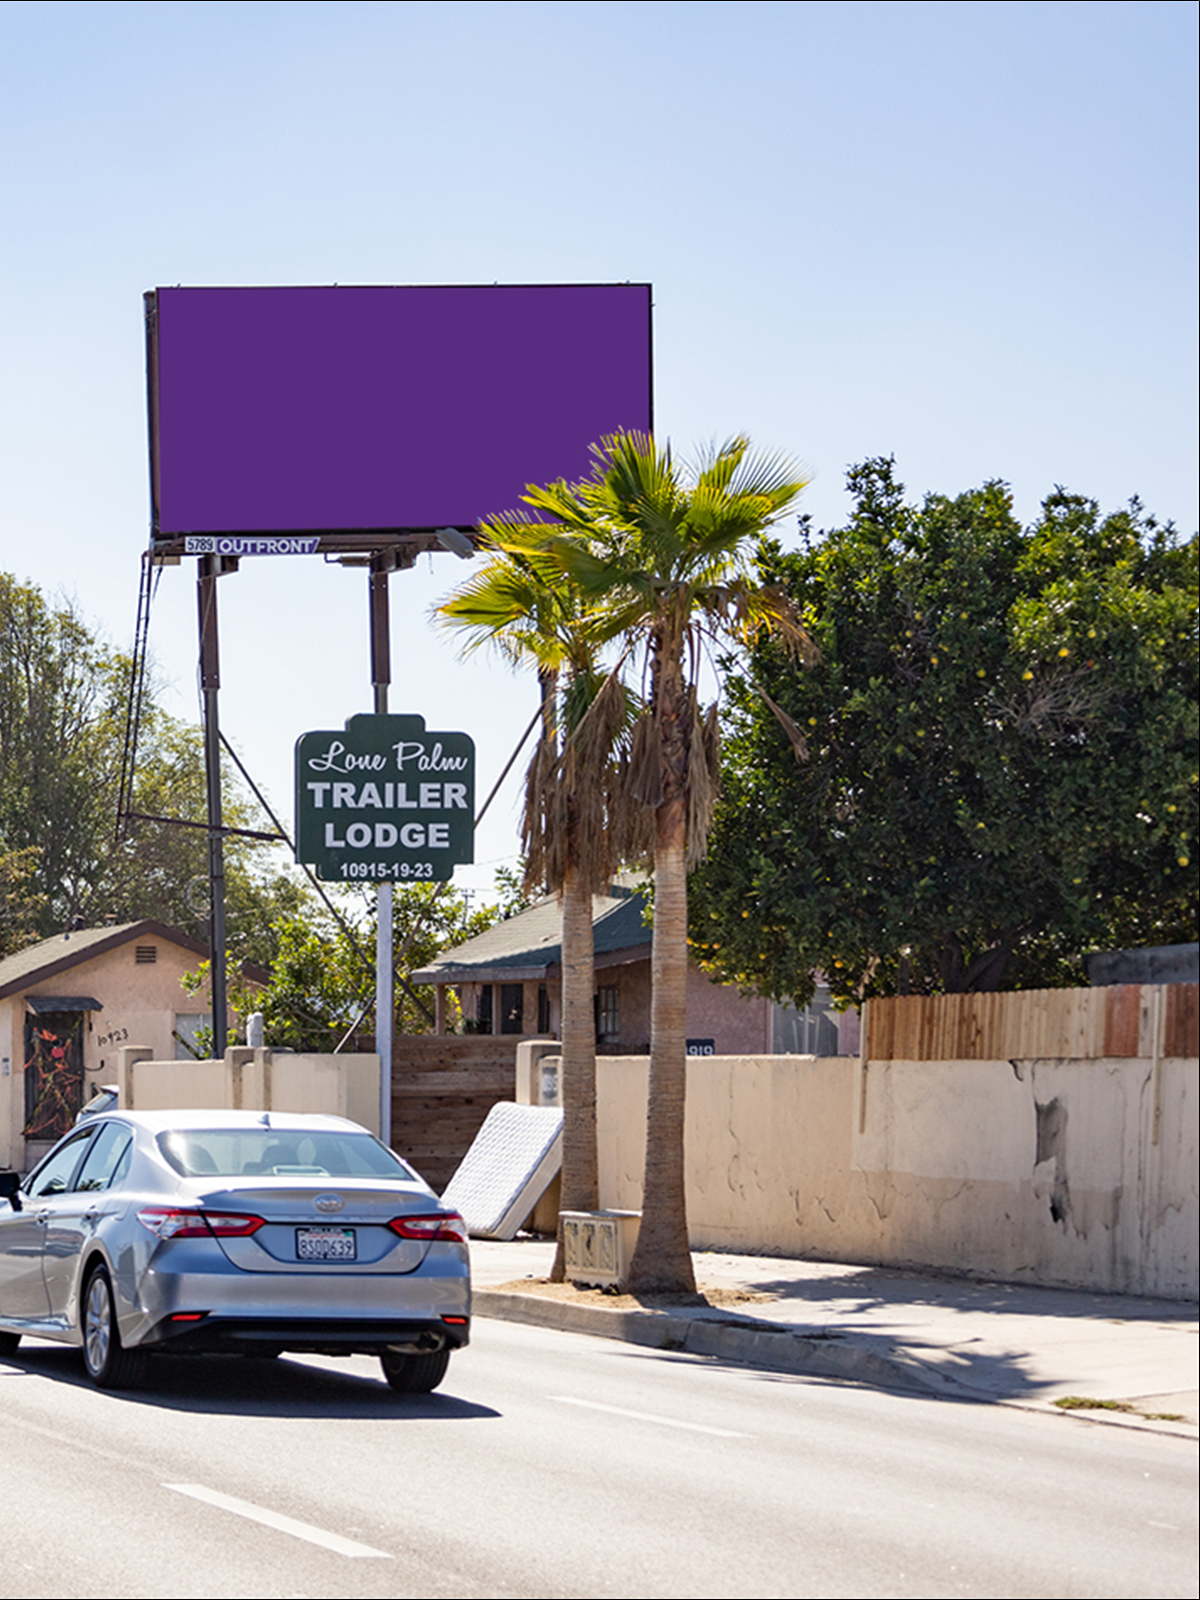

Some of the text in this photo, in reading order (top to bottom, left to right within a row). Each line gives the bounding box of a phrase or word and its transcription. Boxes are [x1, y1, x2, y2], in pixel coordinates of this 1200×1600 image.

[187, 538, 213, 551] 5789
[219, 539, 313, 554] OUTFRONT
[308, 741, 468, 773] Lone Palm
[307, 782, 468, 809] TRAILER
[325, 822, 450, 848] LODGE
[340, 863, 434, 878] 10915-19-23
[686, 1045, 714, 1056] 919
